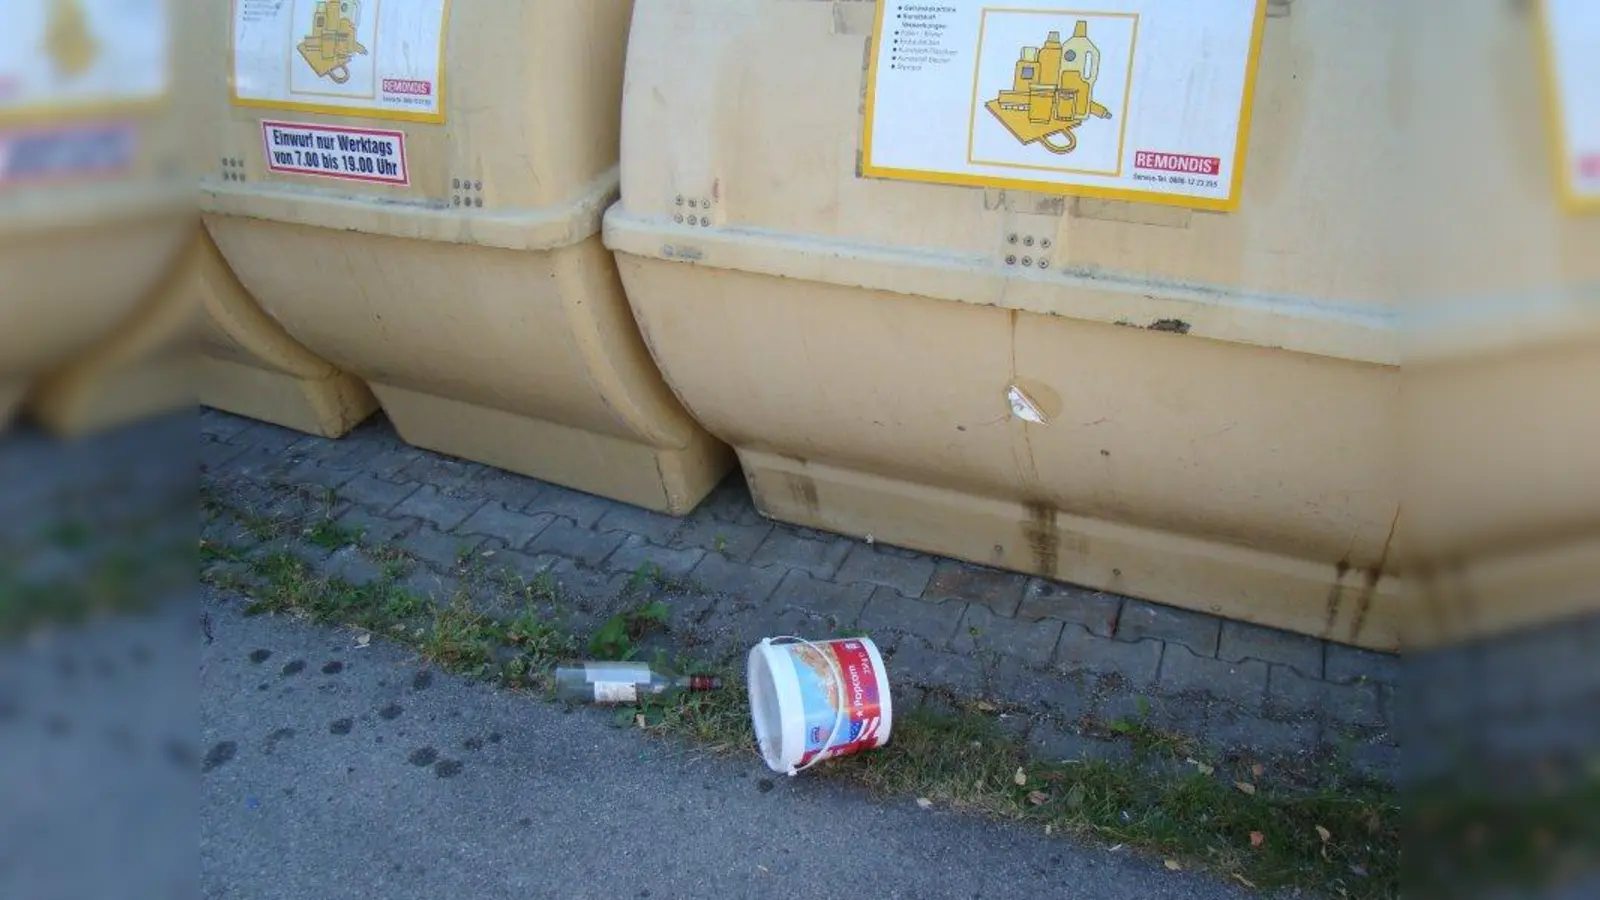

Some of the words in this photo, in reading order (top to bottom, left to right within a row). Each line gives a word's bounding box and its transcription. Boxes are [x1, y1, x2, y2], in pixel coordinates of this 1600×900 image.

[272, 128, 314, 146] Einwurf
[316, 135, 334, 150] nur
[337, 134, 393, 156] Werktags
[274, 152, 293, 166] von
[295, 150, 319, 168] 7.00
[321, 153, 339, 170] bis
[342, 155, 373, 174] 19.00
[376, 157, 398, 176] Uhr
[1136, 152, 1212, 173] REMONDIS
[848, 665, 864, 706] Popcorn
